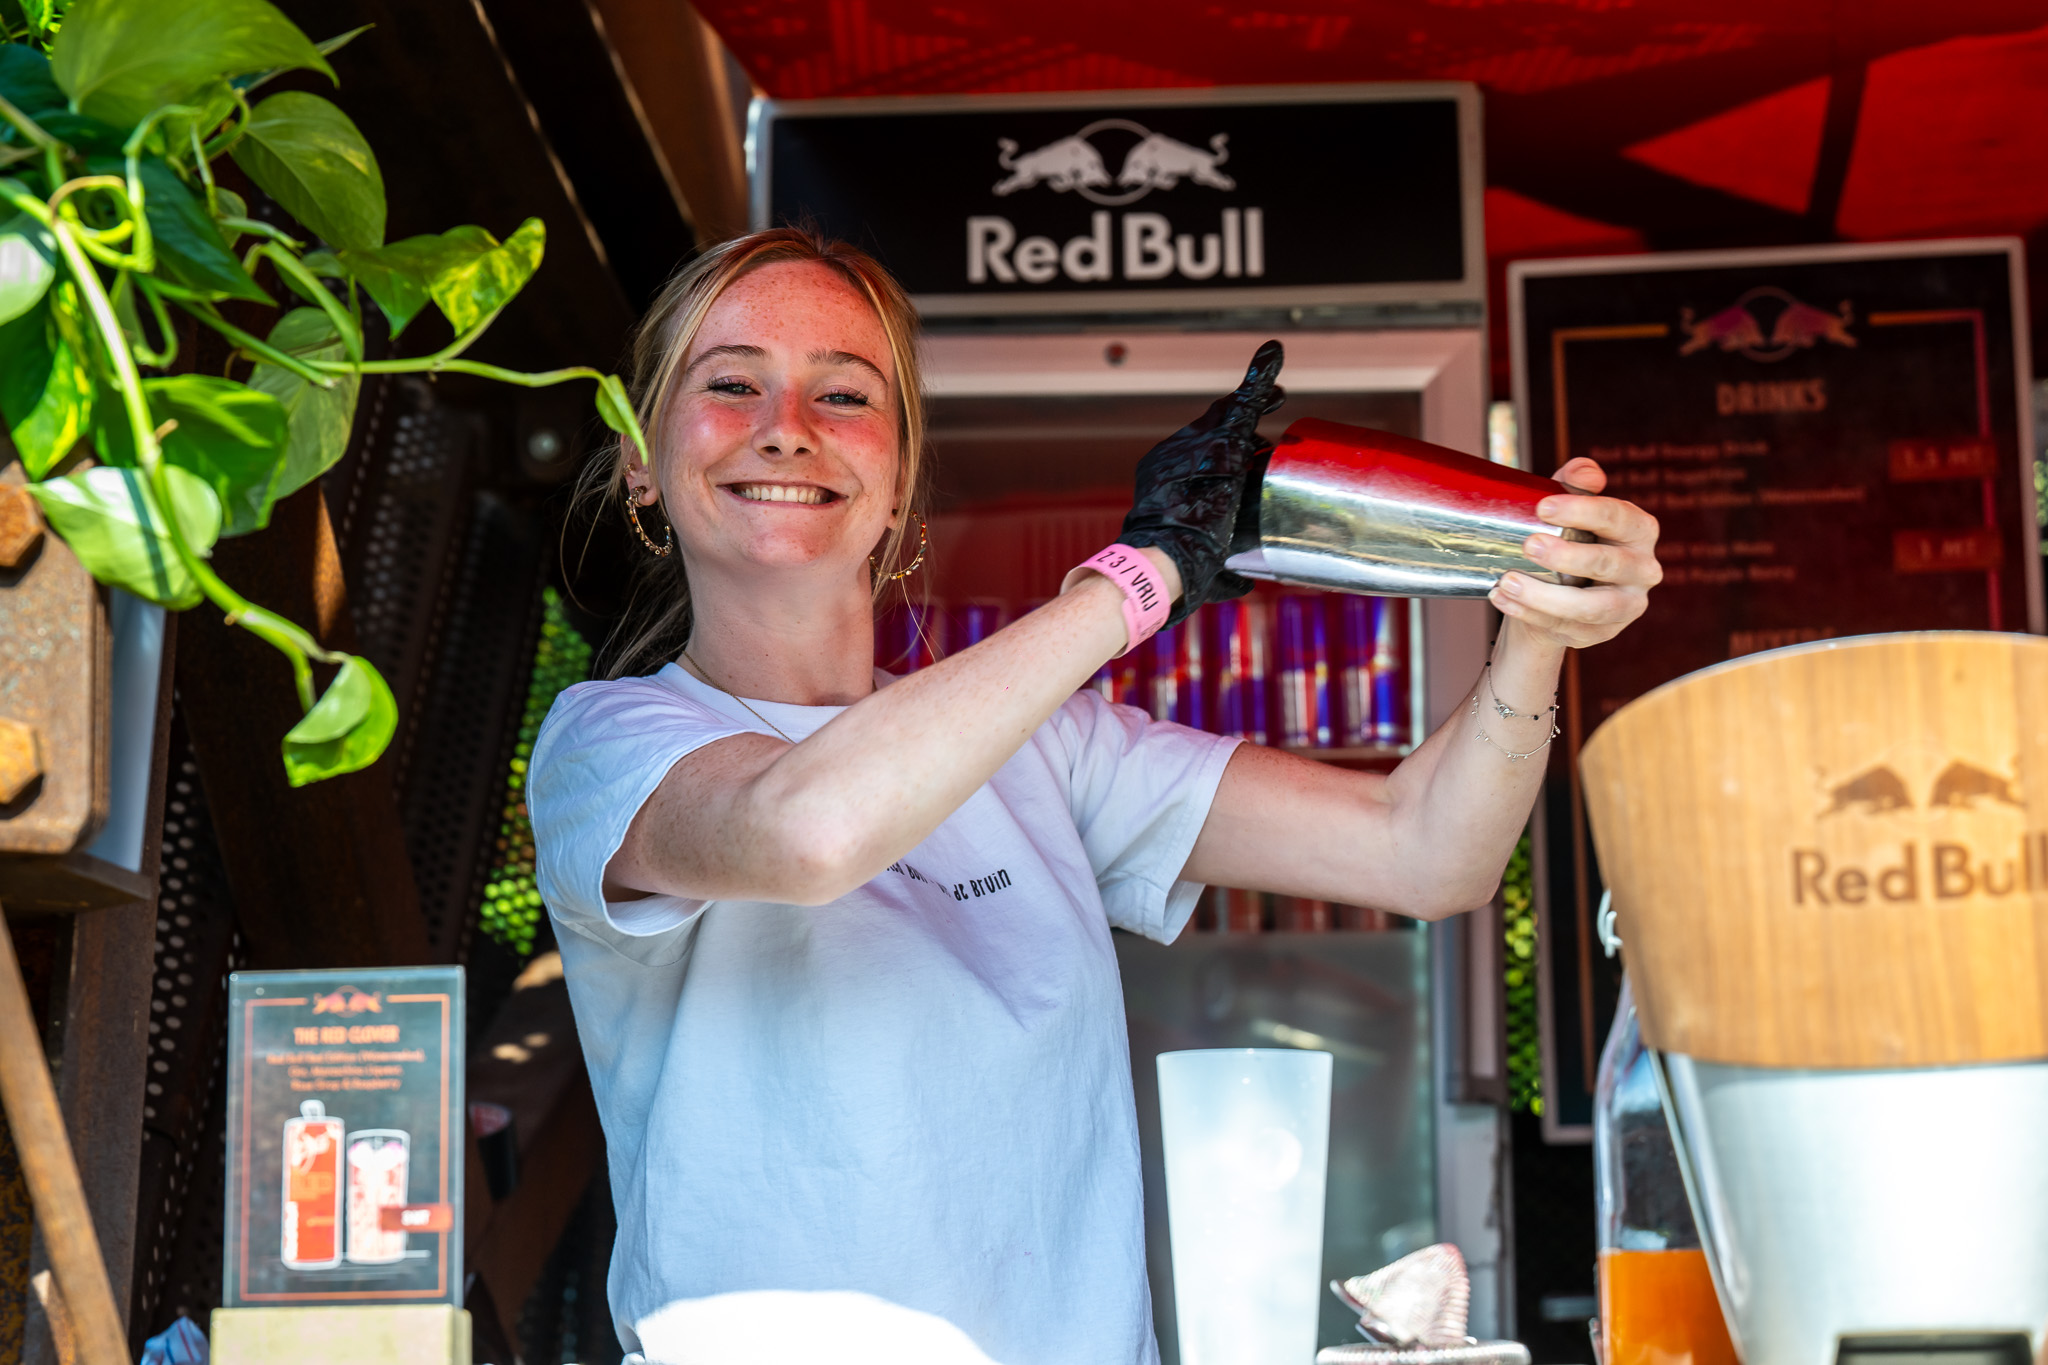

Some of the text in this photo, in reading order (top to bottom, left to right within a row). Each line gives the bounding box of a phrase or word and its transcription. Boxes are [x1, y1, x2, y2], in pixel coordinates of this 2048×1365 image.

[967, 207, 1265, 284] Red Bull
[1716, 377, 1828, 416] DRINKS
[1130, 571, 1160, 612] VRIJ
[1791, 831, 2048, 905] Red Bull
[953, 883, 969, 901] de
[293, 1024, 400, 1045] THE RED CLOVER
